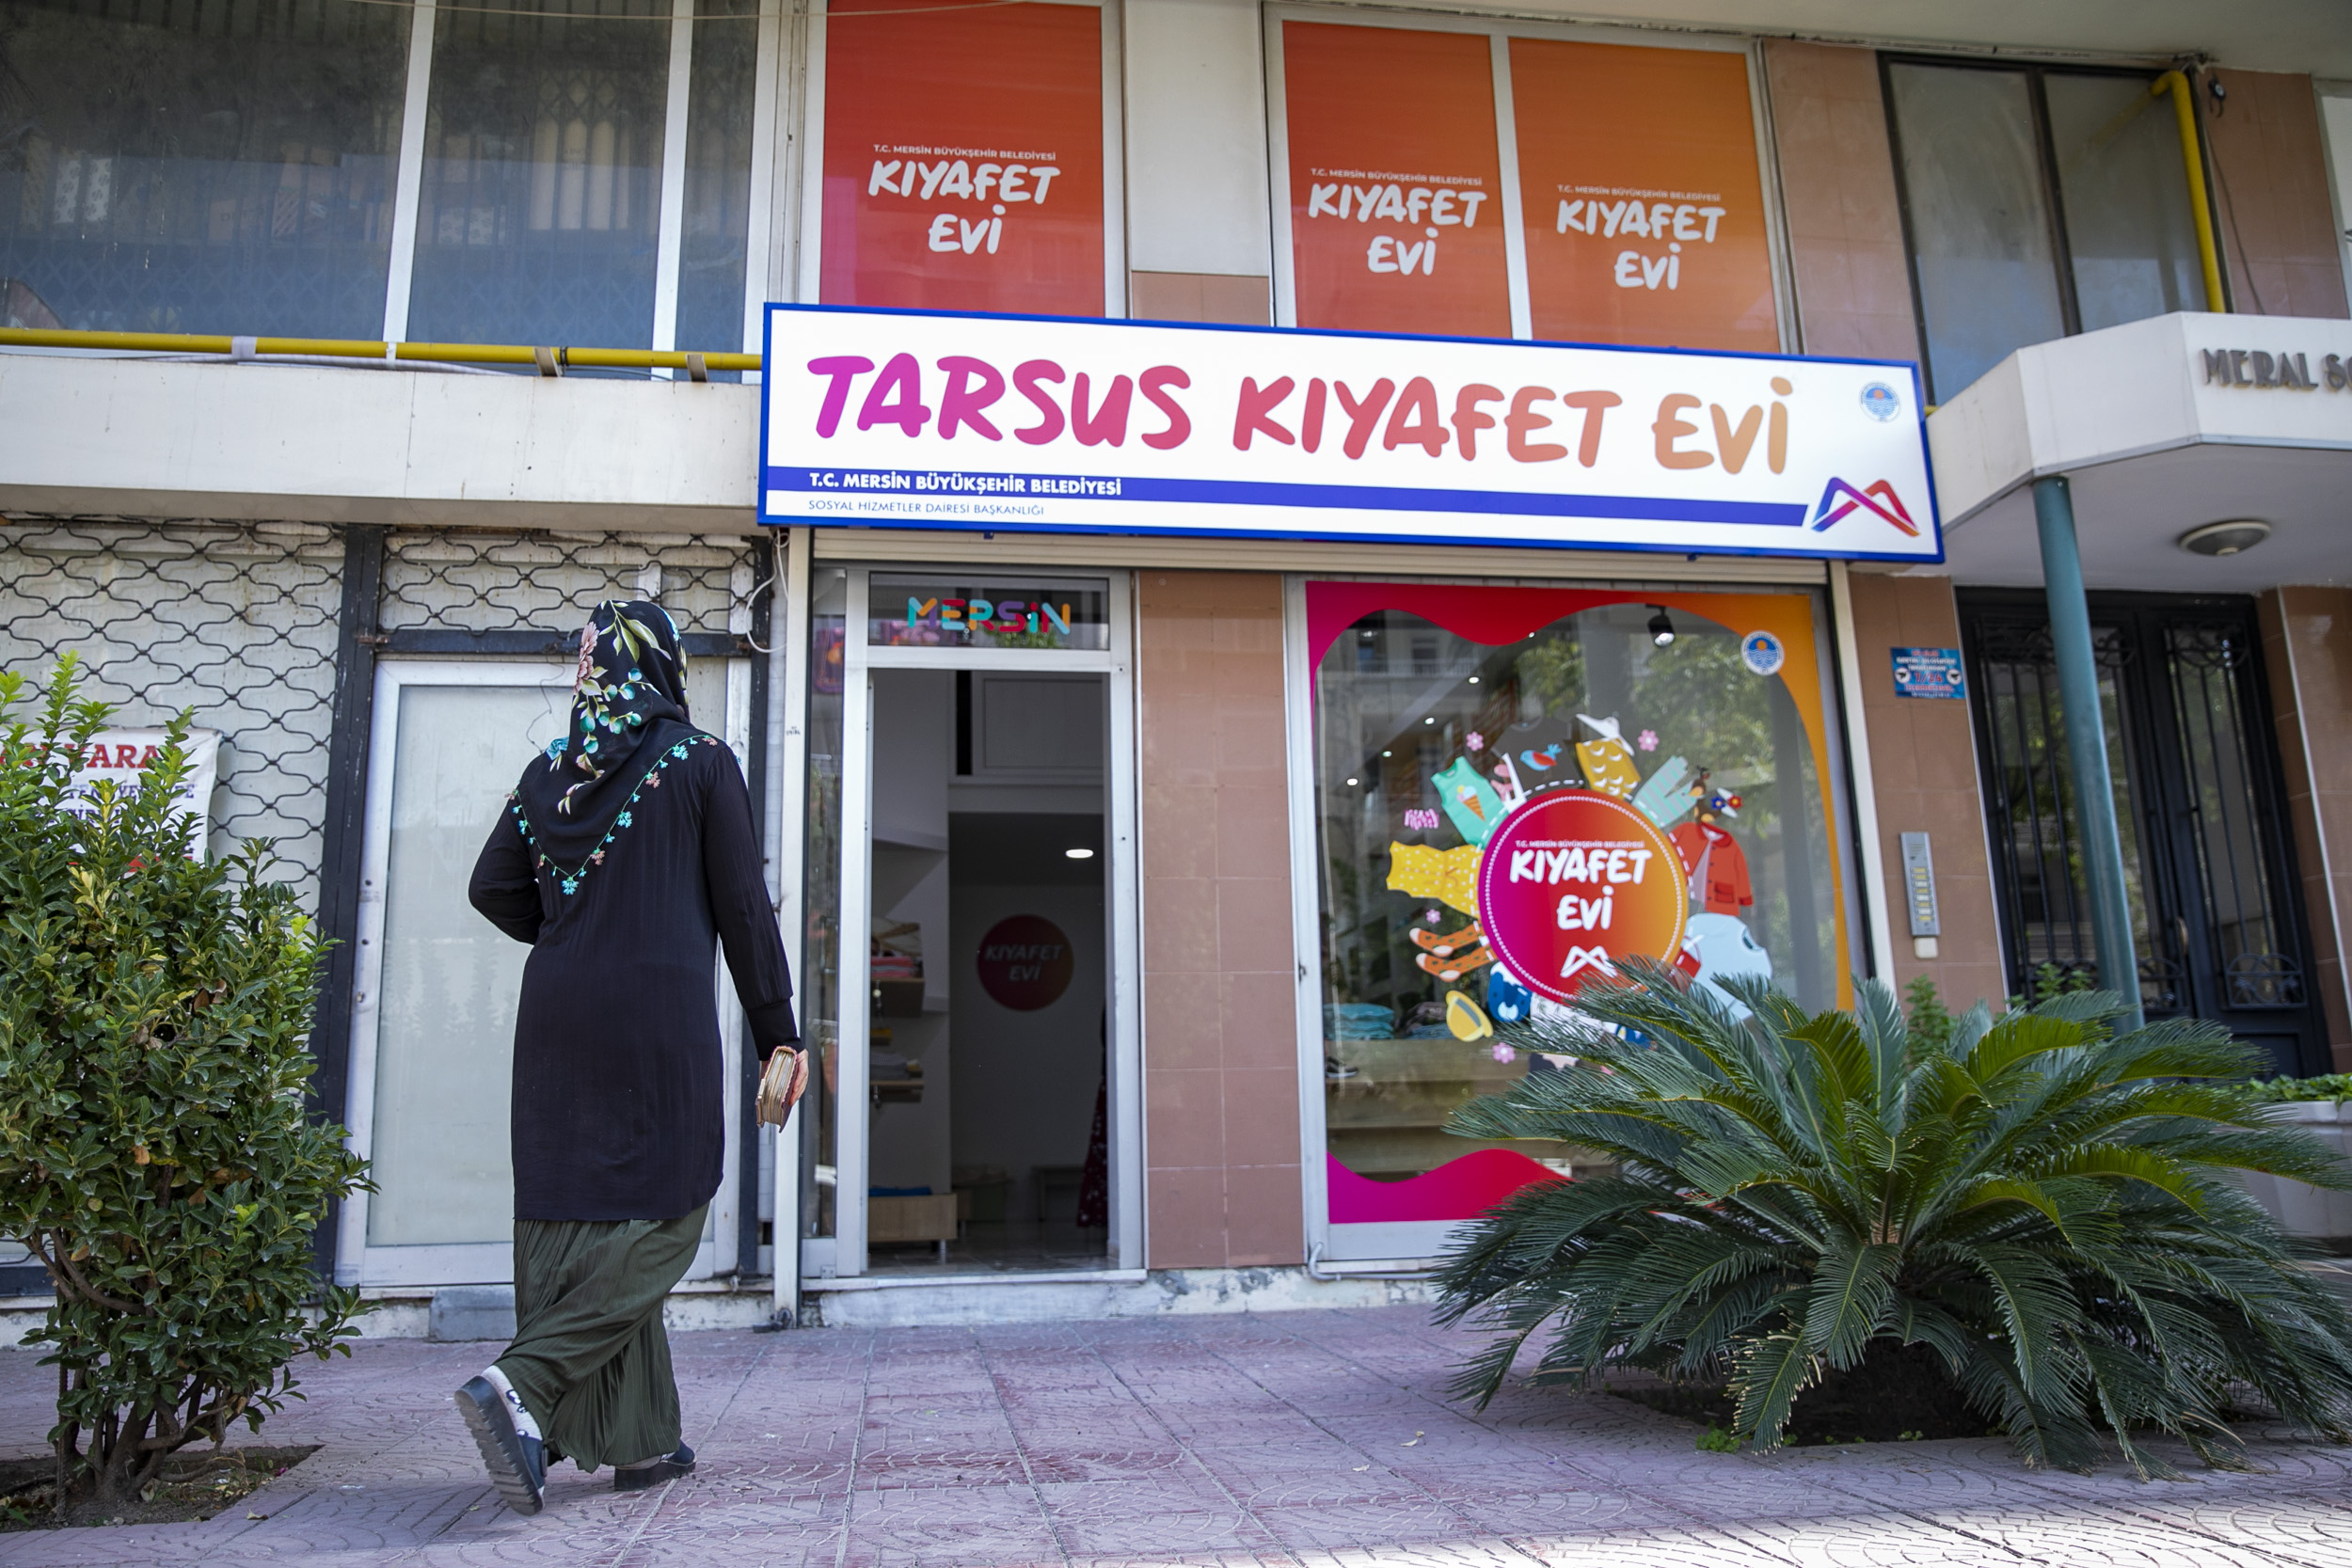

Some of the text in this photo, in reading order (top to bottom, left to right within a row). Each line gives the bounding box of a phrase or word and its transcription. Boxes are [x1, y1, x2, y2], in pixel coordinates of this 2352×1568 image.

[874, 144, 1057, 161] T.C. MERSİN BÜYÜKŞEHİR BELEDİYESİ
[867, 159, 1061, 205] KIYAFET
[1311, 168, 1483, 185] T.C. MERSİN BÜYÜKŞEHİR BELEDİYESİ
[1308, 182, 1487, 228] KIYAFET
[1556, 198, 1726, 244] KIYAFET
[928, 203, 1007, 255] EVİ
[1366, 227, 1439, 276] EVİ
[1613, 242, 1681, 291] EVİ
[2200, 348, 2319, 390] MERAL
[806, 352, 1192, 451] TARSUS
[1232, 375, 1623, 468] KIYAFET
[1651, 375, 1793, 475] EVİ
[809, 470, 1121, 496] T.C. MERSİN BÜYÜKŞEHİR BELEDİYESİ
[808, 499, 1044, 515] SOSYAL HİZMETLER DAİRESİ BAŞKANLIĞI
[1509, 847, 1653, 885] KIYAFET
[1556, 885, 1614, 931] EVİ
[985, 944, 1064, 959] KIYAFET
[1009, 961, 1042, 981] EVİ
